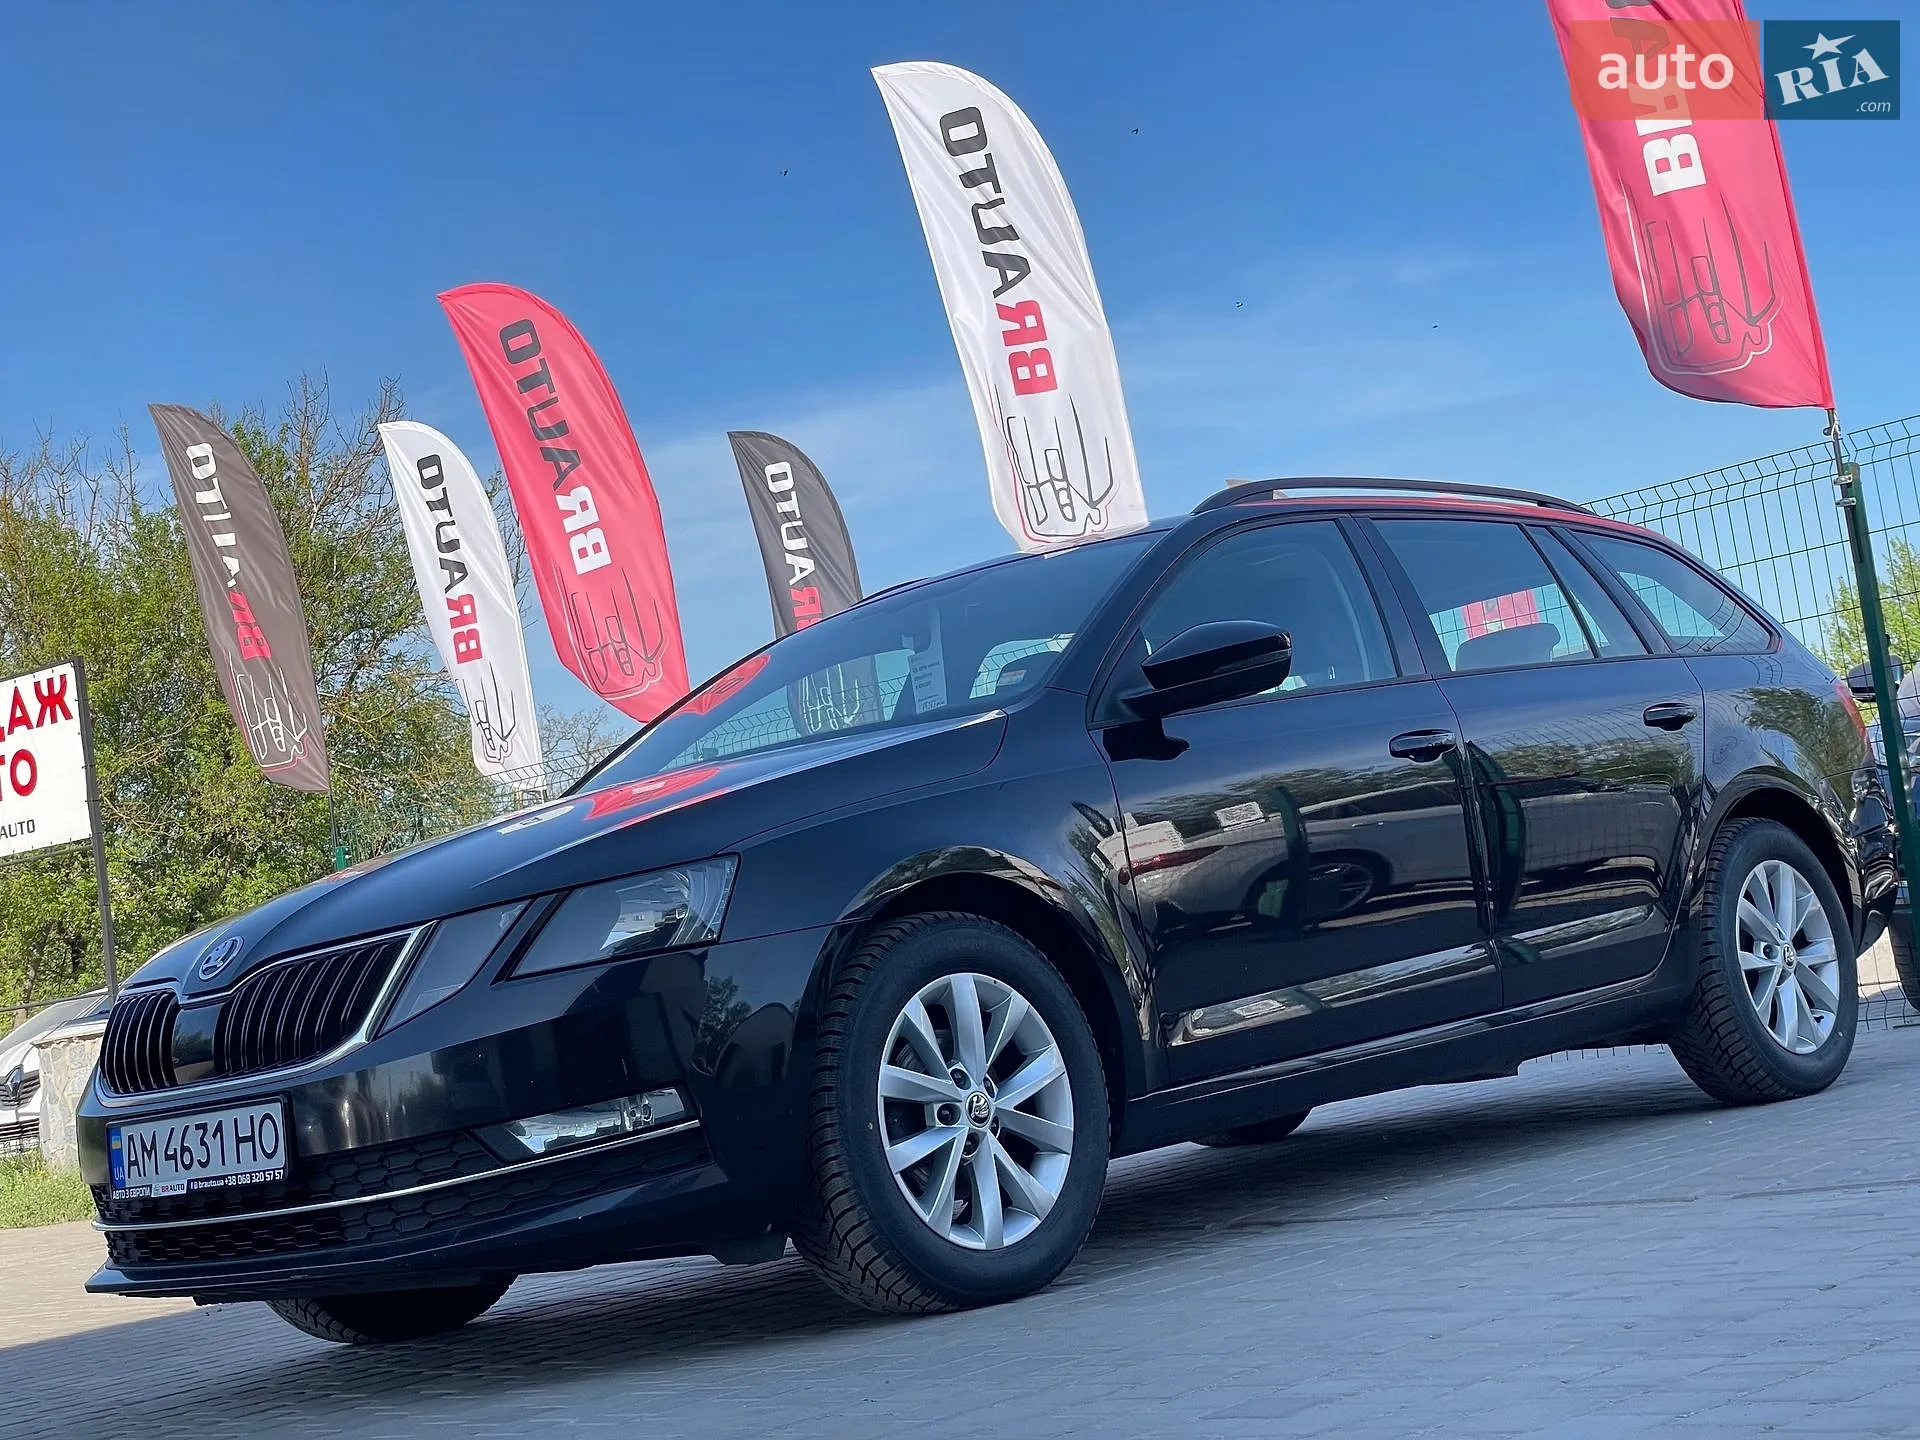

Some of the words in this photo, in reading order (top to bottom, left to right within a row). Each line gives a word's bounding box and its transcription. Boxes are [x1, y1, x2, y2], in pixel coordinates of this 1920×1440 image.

[0, 674, 73, 743] АЖ
[127, 1130, 159, 1179] AM
[164, 1119, 226, 1172] 4631
[233, 1112, 279, 1164] HO
[114, 1166, 125, 1181] UA
[252, 1172, 265, 1182] 320
[265, 1170, 274, 1181] 57
[274, 1169, 284, 1180] 57
